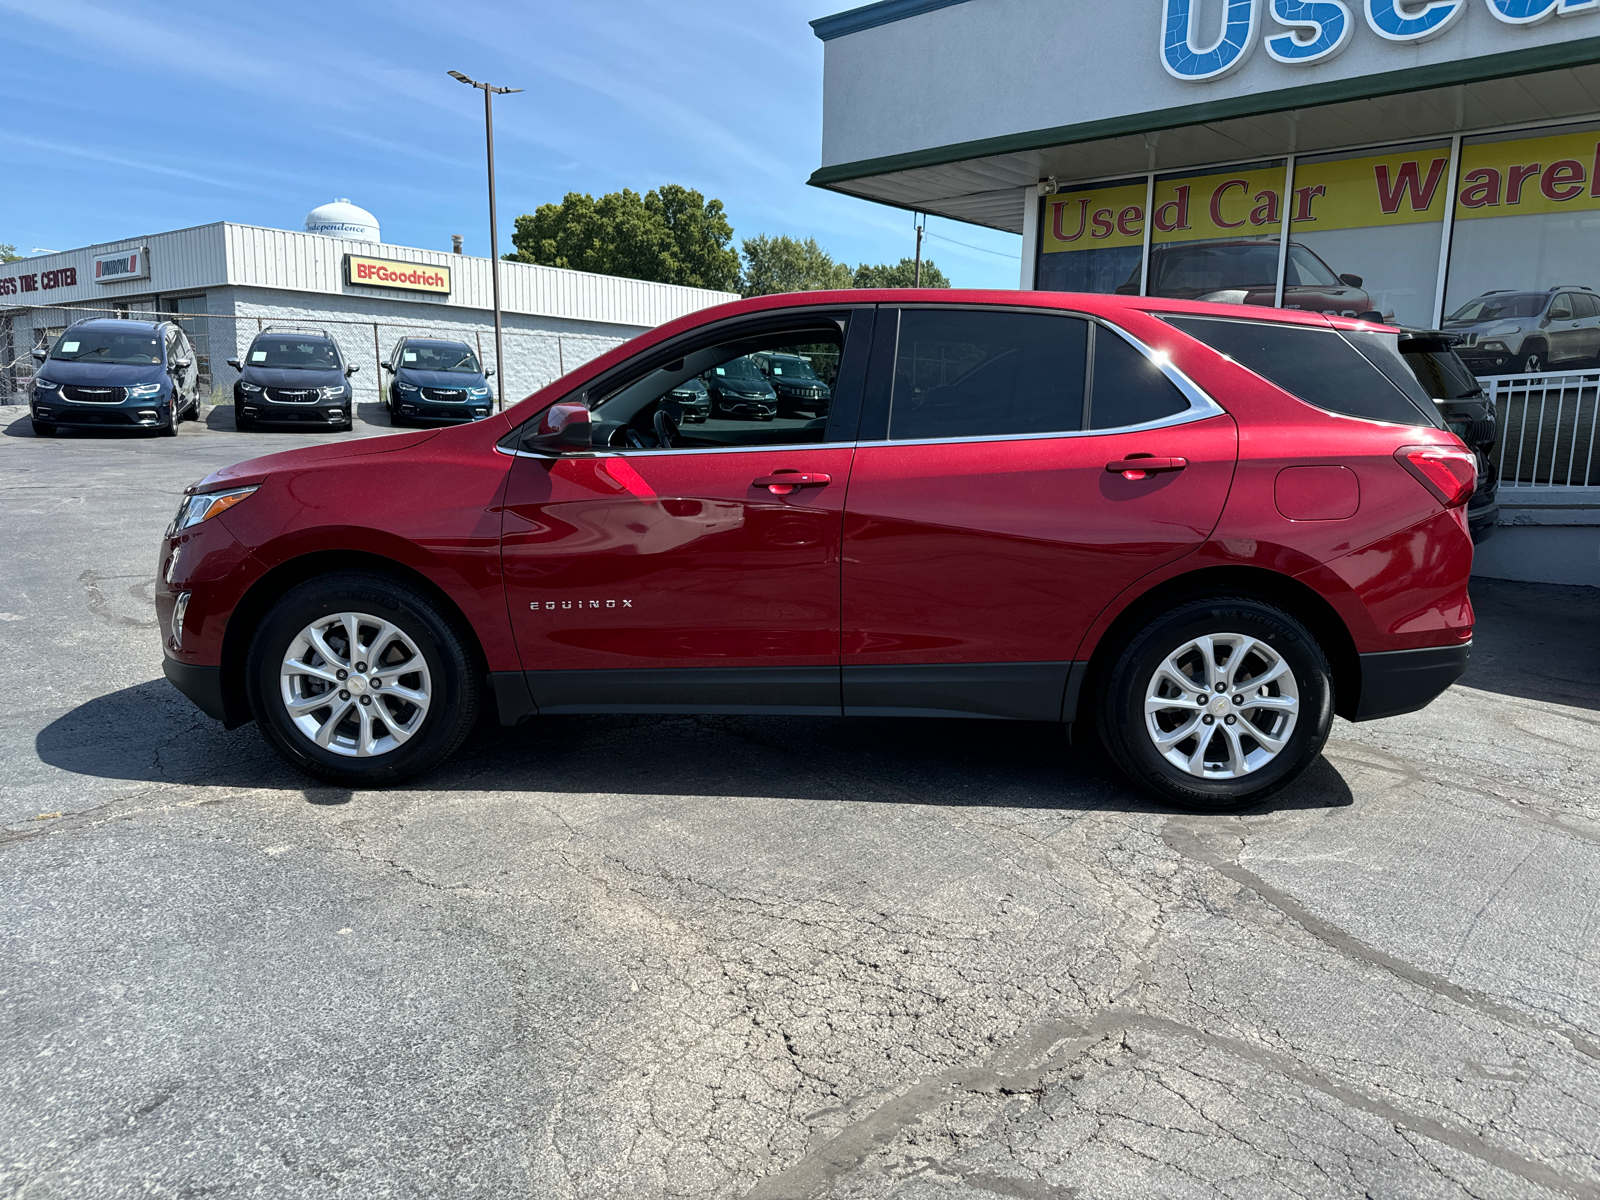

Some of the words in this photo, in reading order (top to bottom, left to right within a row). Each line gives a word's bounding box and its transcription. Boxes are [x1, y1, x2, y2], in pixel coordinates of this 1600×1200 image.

[1160, 0, 1600, 81] Use
[1050, 183, 1192, 243] Used
[1209, 179, 1327, 230] Car
[101, 257, 130, 277] UNIROYAL
[357, 263, 445, 288] BFGoodrich
[18, 273, 39, 293] TIRE
[41, 267, 77, 290] CENTER
[336, 590, 399, 611] MICHELIN
[529, 599, 633, 611] EQUINOX
[1240, 611, 1299, 642] MICHELIN
